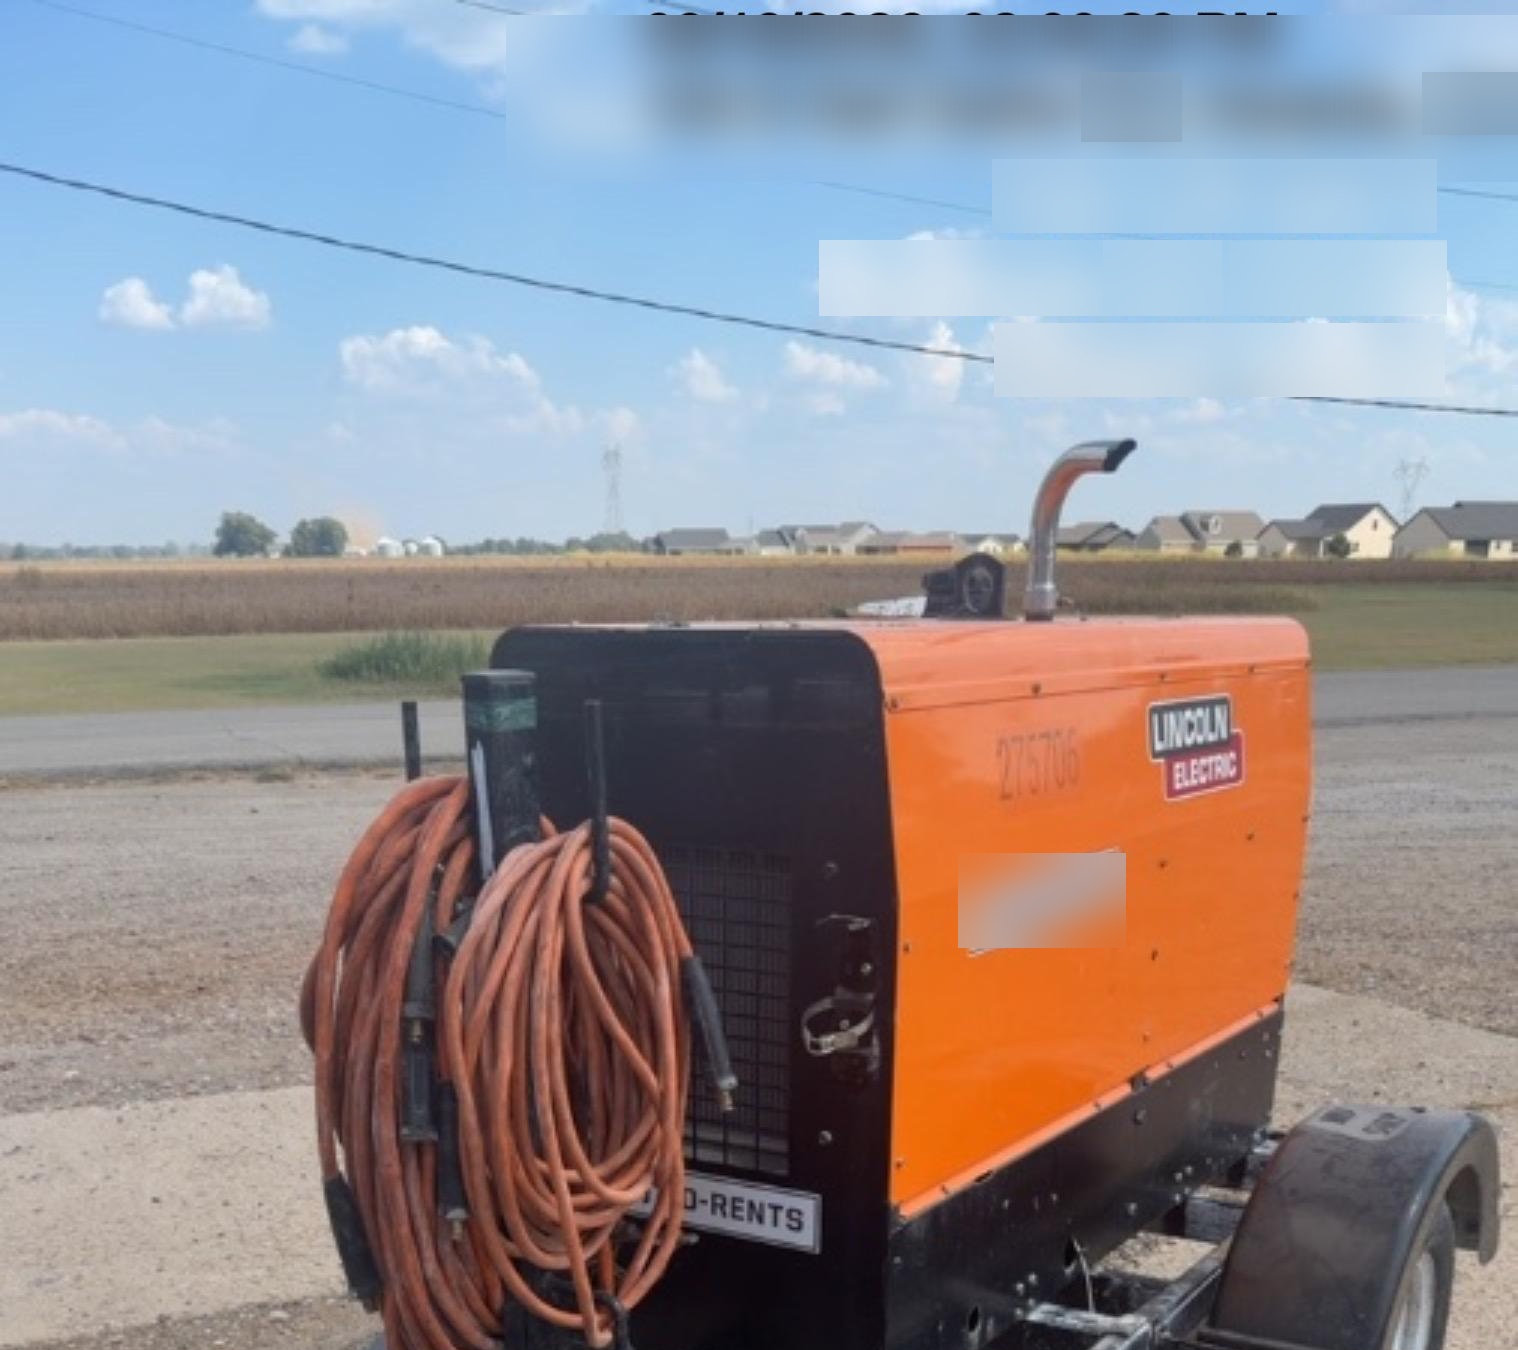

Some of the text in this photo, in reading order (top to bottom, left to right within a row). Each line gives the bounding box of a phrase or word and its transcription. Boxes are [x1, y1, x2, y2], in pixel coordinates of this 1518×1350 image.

[1152, 703, 1228, 751] LINCOLN
[996, 726, 1080, 801] 275706
[1172, 752, 1237, 791] ELECTRIC
